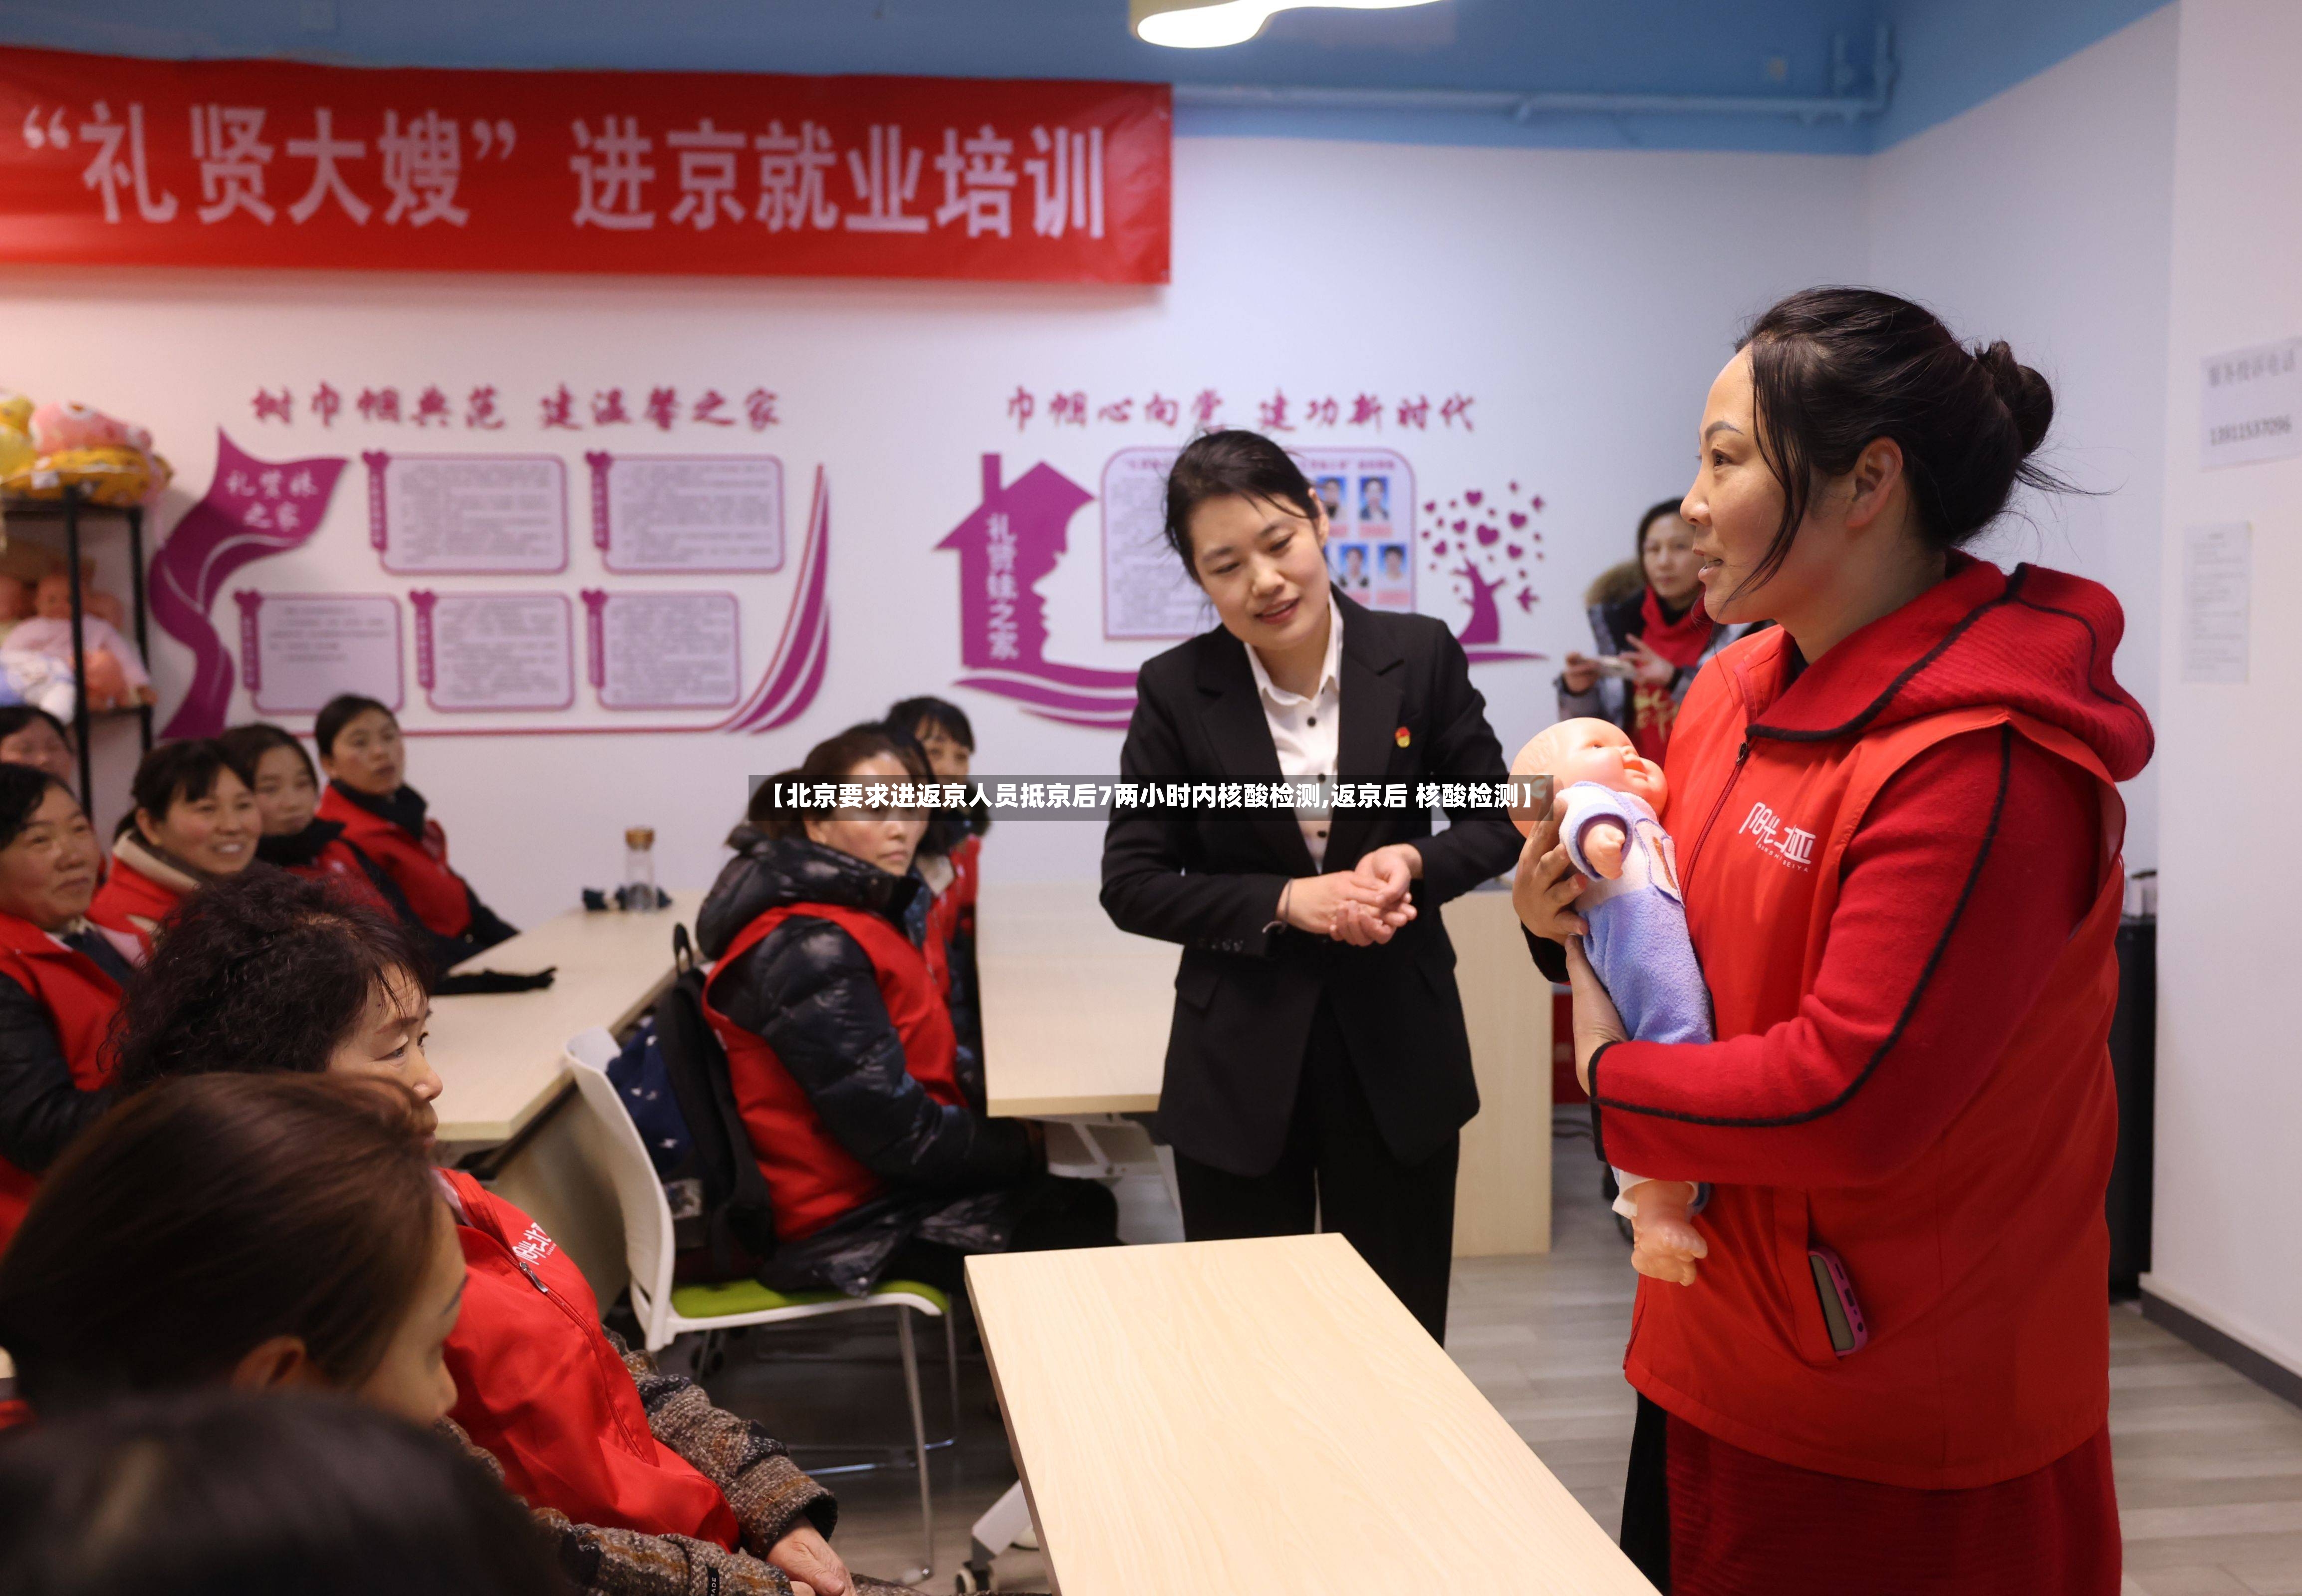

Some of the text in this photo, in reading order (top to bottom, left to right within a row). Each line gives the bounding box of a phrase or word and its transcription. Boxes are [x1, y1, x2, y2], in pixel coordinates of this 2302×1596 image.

[21, 103, 1106, 240] “礼贤大嫂” 进京就业培训
[1259, 387, 1474, 433] 建功新时代
